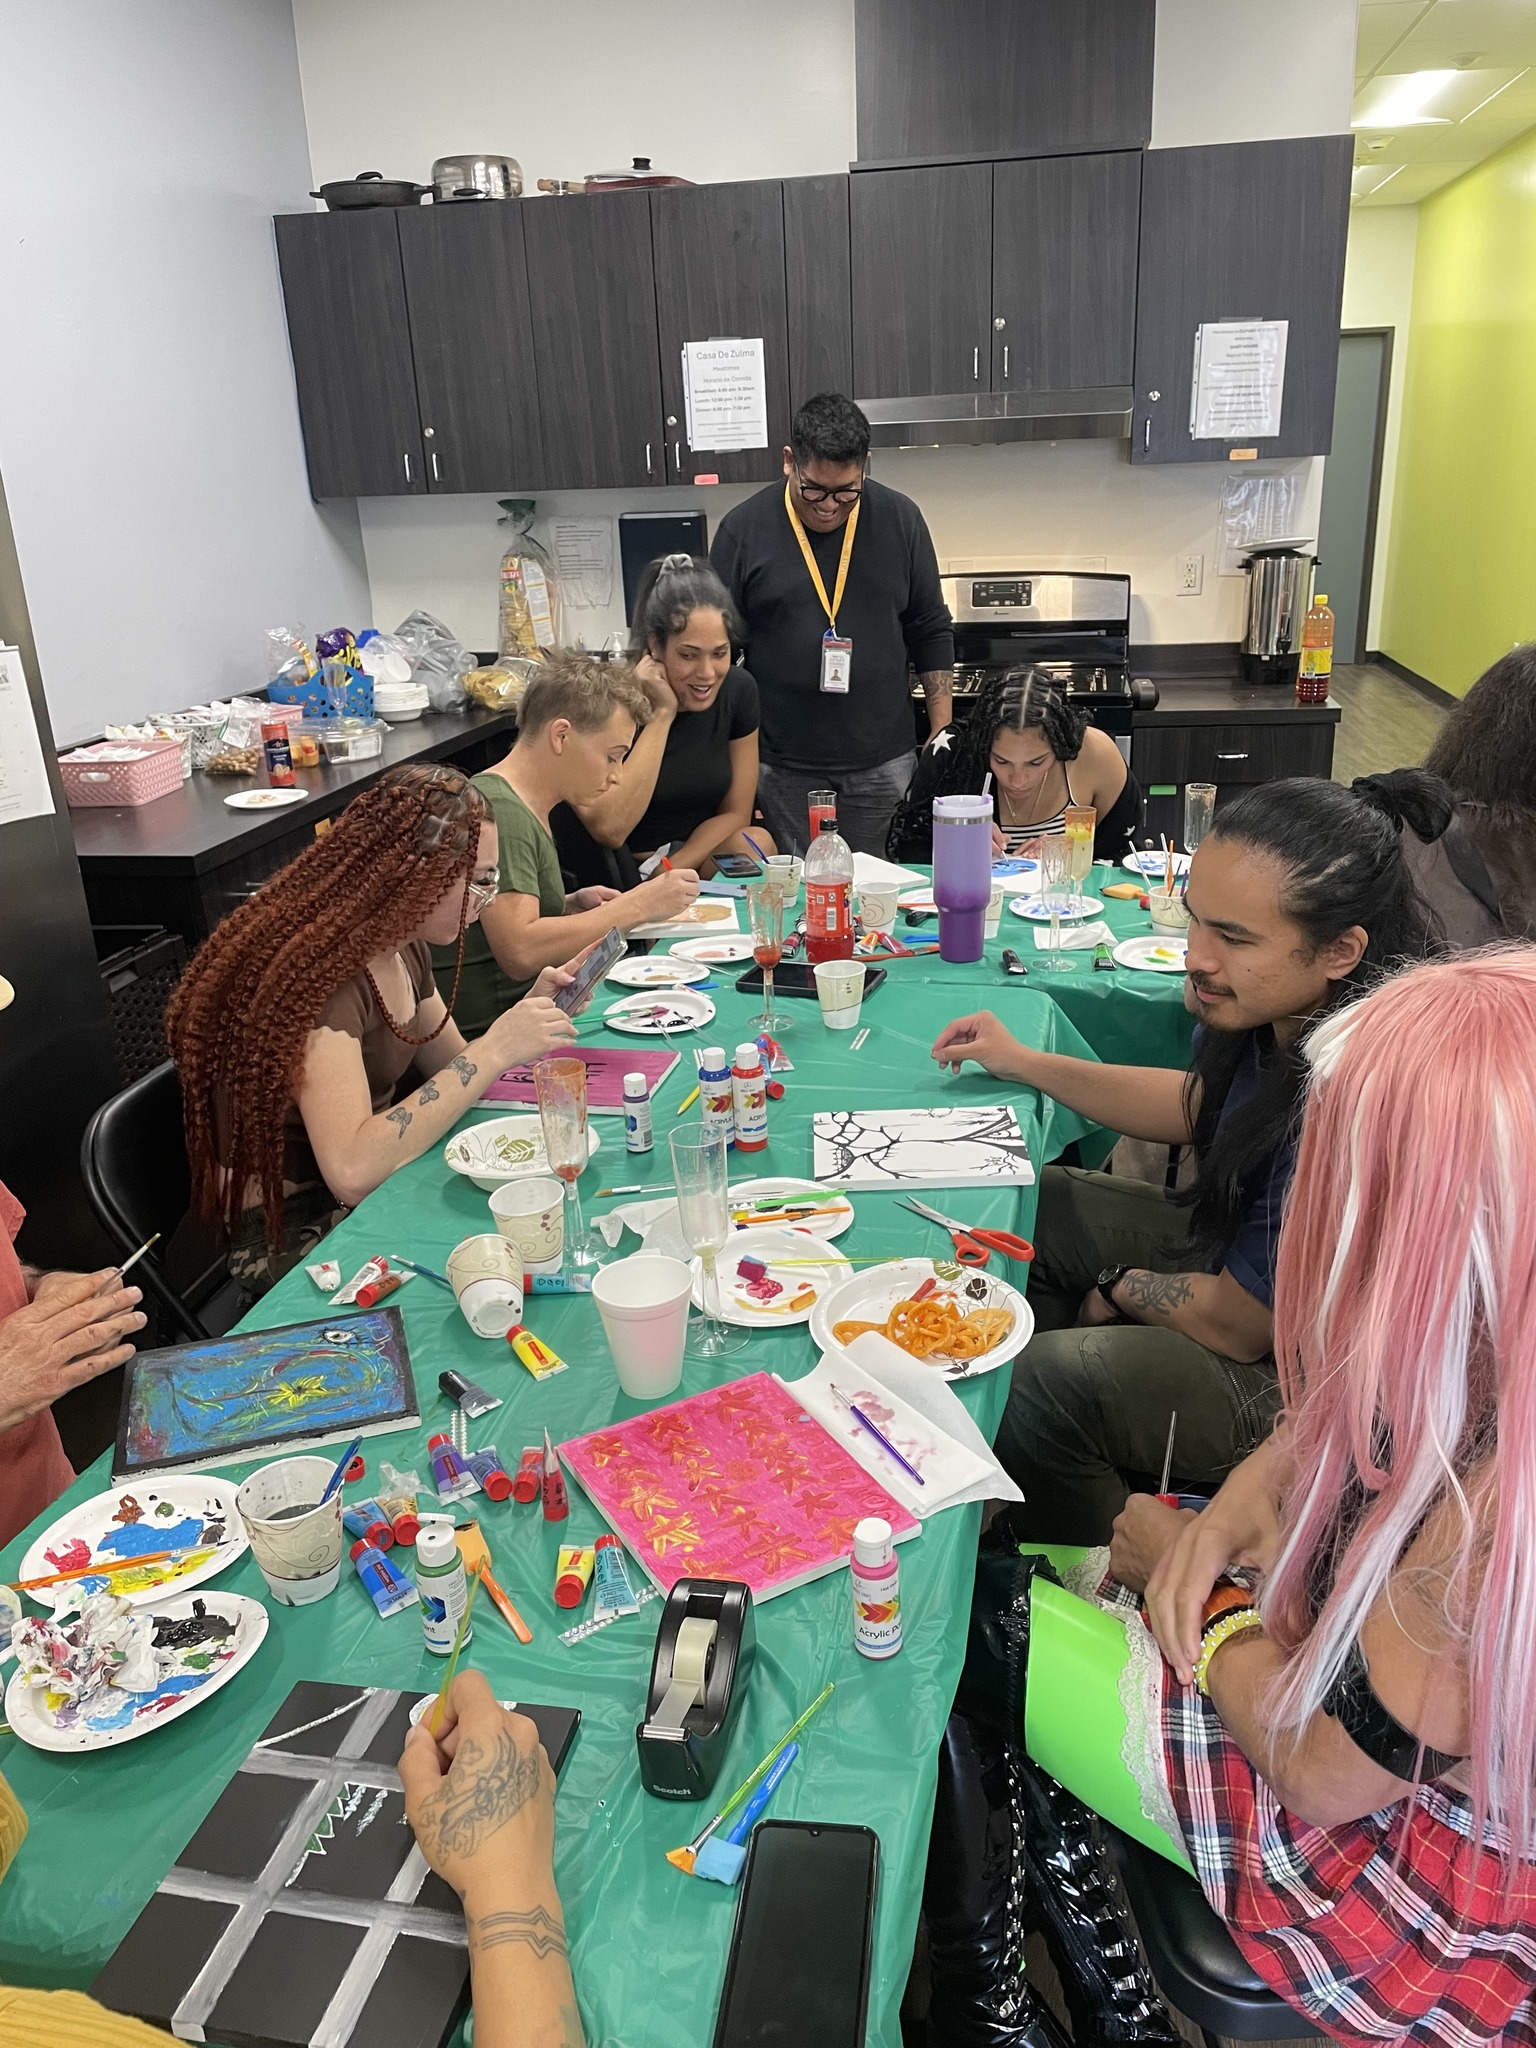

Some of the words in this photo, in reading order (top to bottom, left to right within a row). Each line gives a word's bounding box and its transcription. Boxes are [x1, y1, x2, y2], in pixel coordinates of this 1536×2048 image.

[696, 351, 717, 360] Casa
[718, 350, 729, 358] De
[730, 349, 754, 358] Zulma
[859, 1627, 890, 1639] Acrylic
[652, 1784, 692, 1796] Scotch
